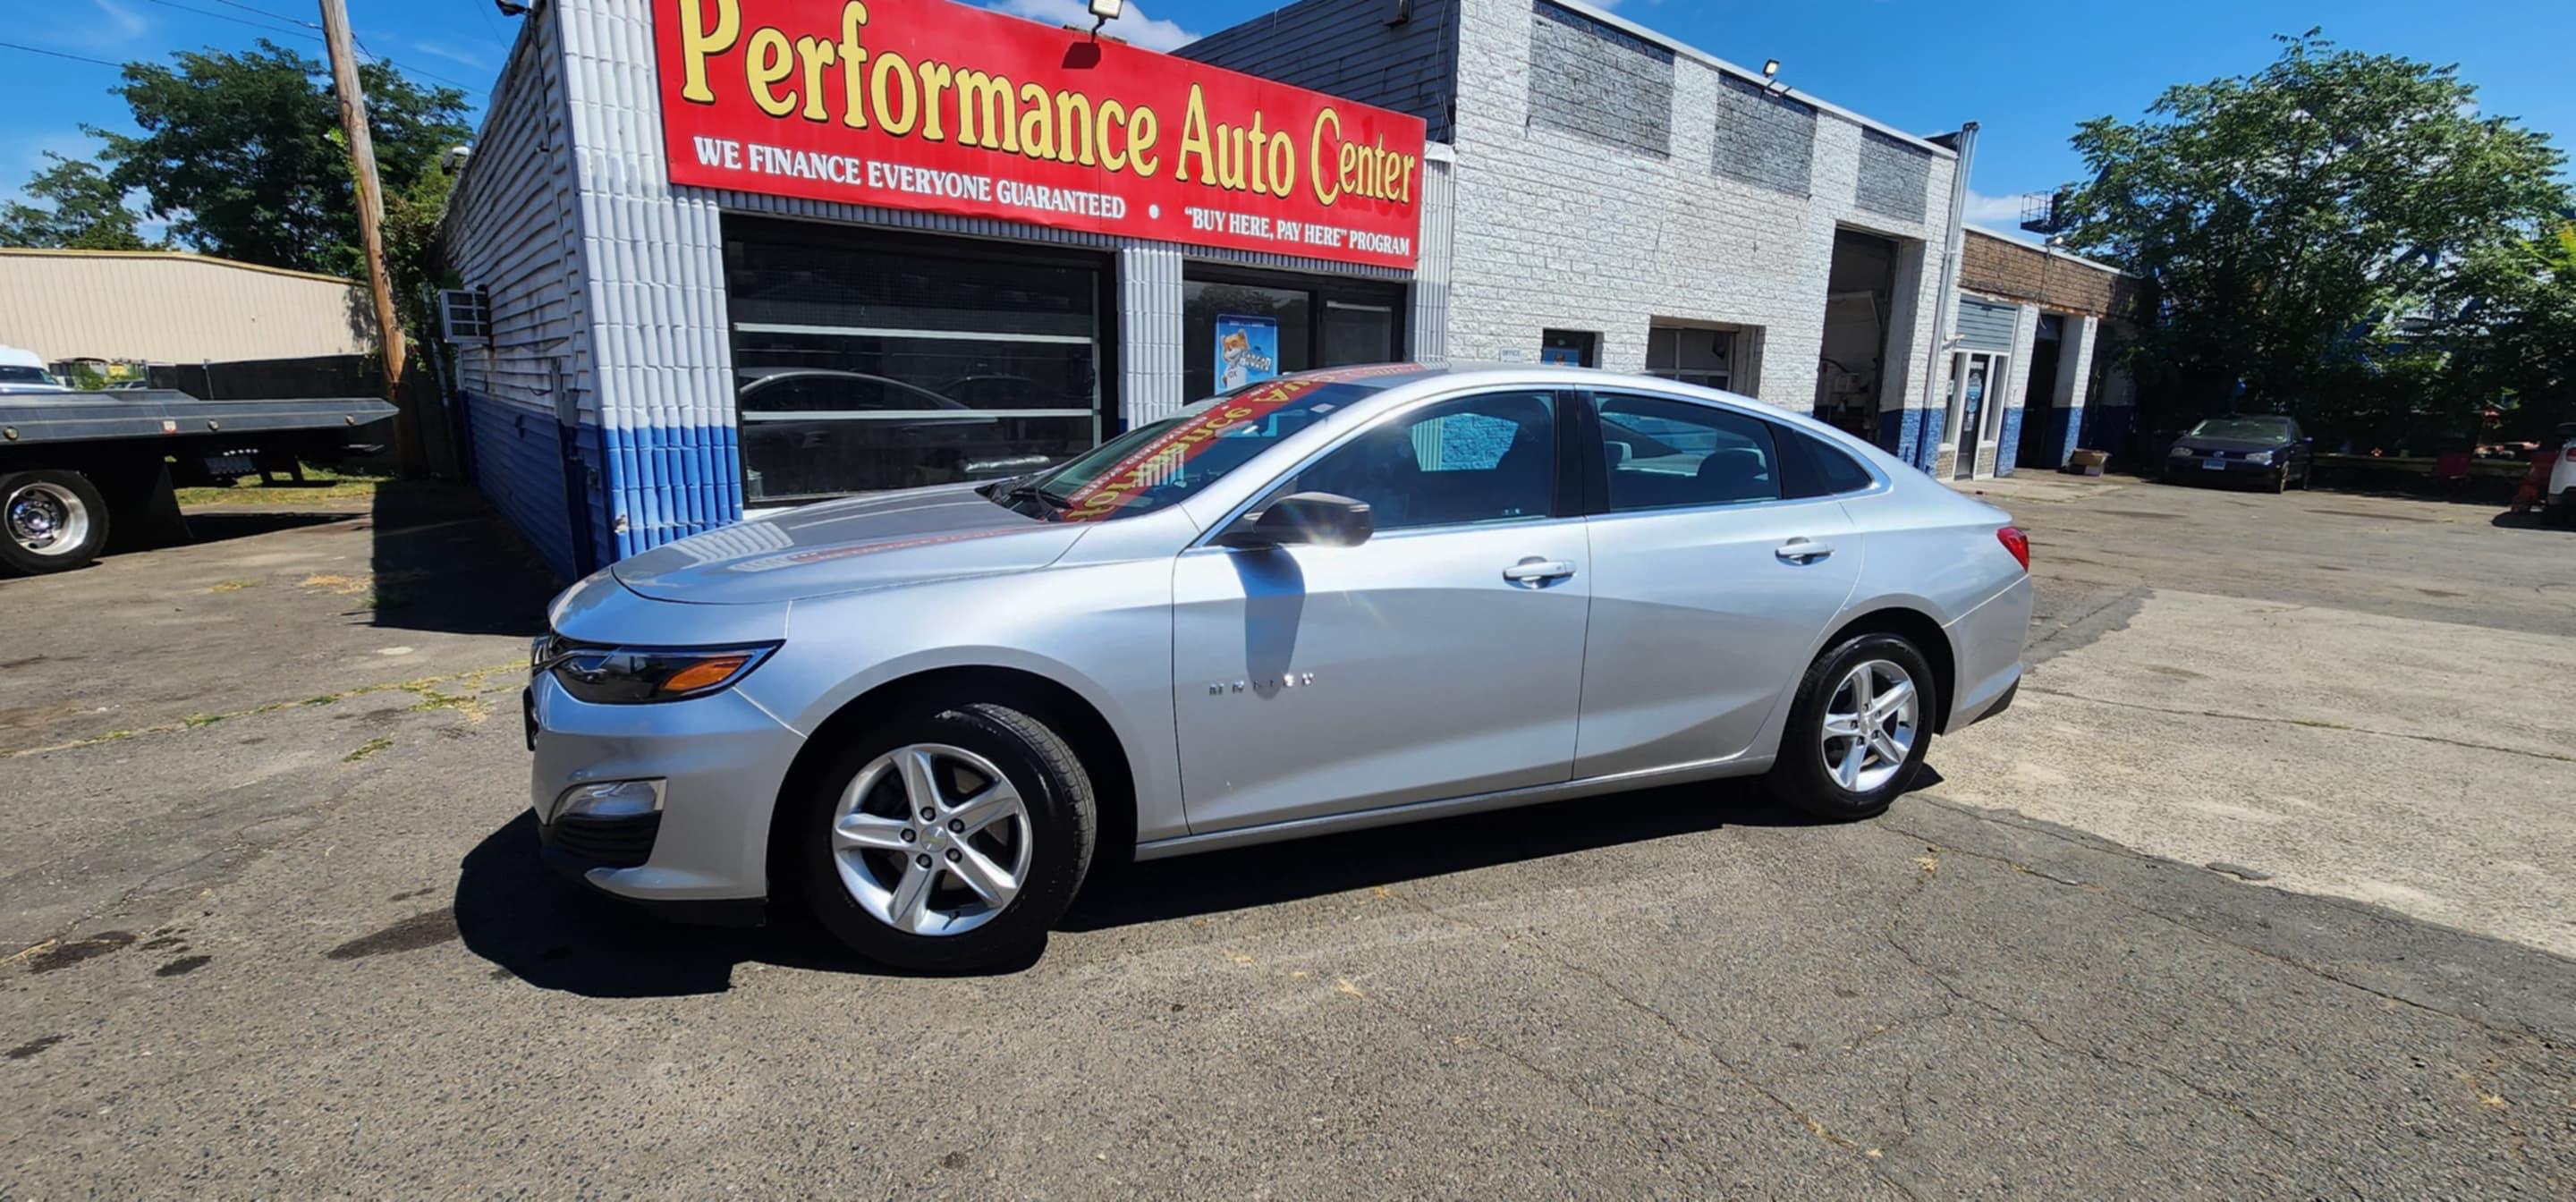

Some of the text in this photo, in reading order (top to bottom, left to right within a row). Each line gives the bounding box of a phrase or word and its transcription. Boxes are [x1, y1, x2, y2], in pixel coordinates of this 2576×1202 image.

[679, 0, 1415, 206] Performance Auto Center
[693, 136, 742, 170] WE
[748, 143, 861, 186] FINANCE
[867, 161, 991, 202] EVERYONE
[996, 180, 1126, 220] GUARANTEED
[1229, 213, 1275, 241] HERE,
[1276, 219, 1302, 242] PAY
[1349, 230, 1411, 257] PROGRAM
